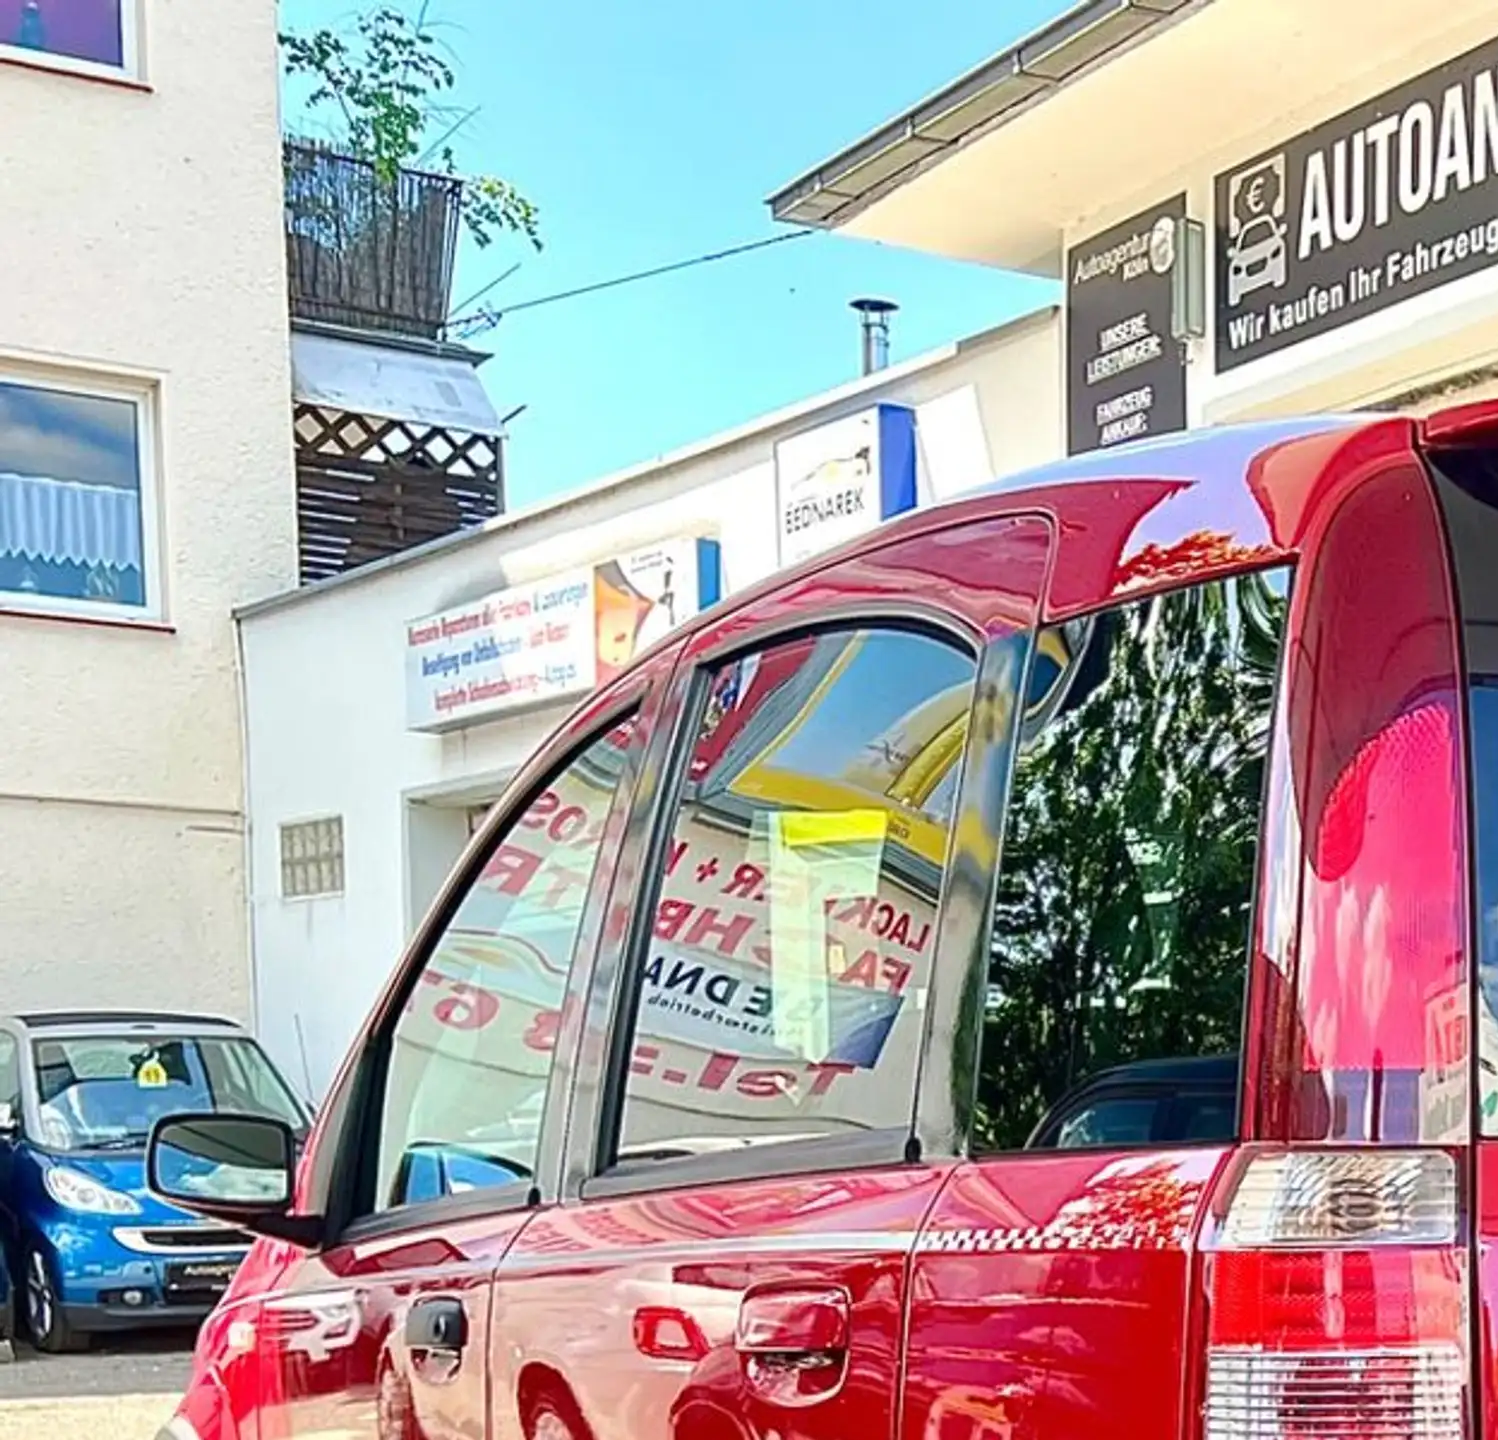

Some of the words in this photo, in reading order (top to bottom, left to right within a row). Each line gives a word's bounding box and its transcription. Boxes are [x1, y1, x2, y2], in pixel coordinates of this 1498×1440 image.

[1073, 233, 1150, 284] Autoagentur
[1228, 311, 1264, 350] Wir
[1269, 282, 1344, 335] kaufen
[1349, 264, 1382, 304] Ihr
[786, 487, 865, 534] BEDNAREK
